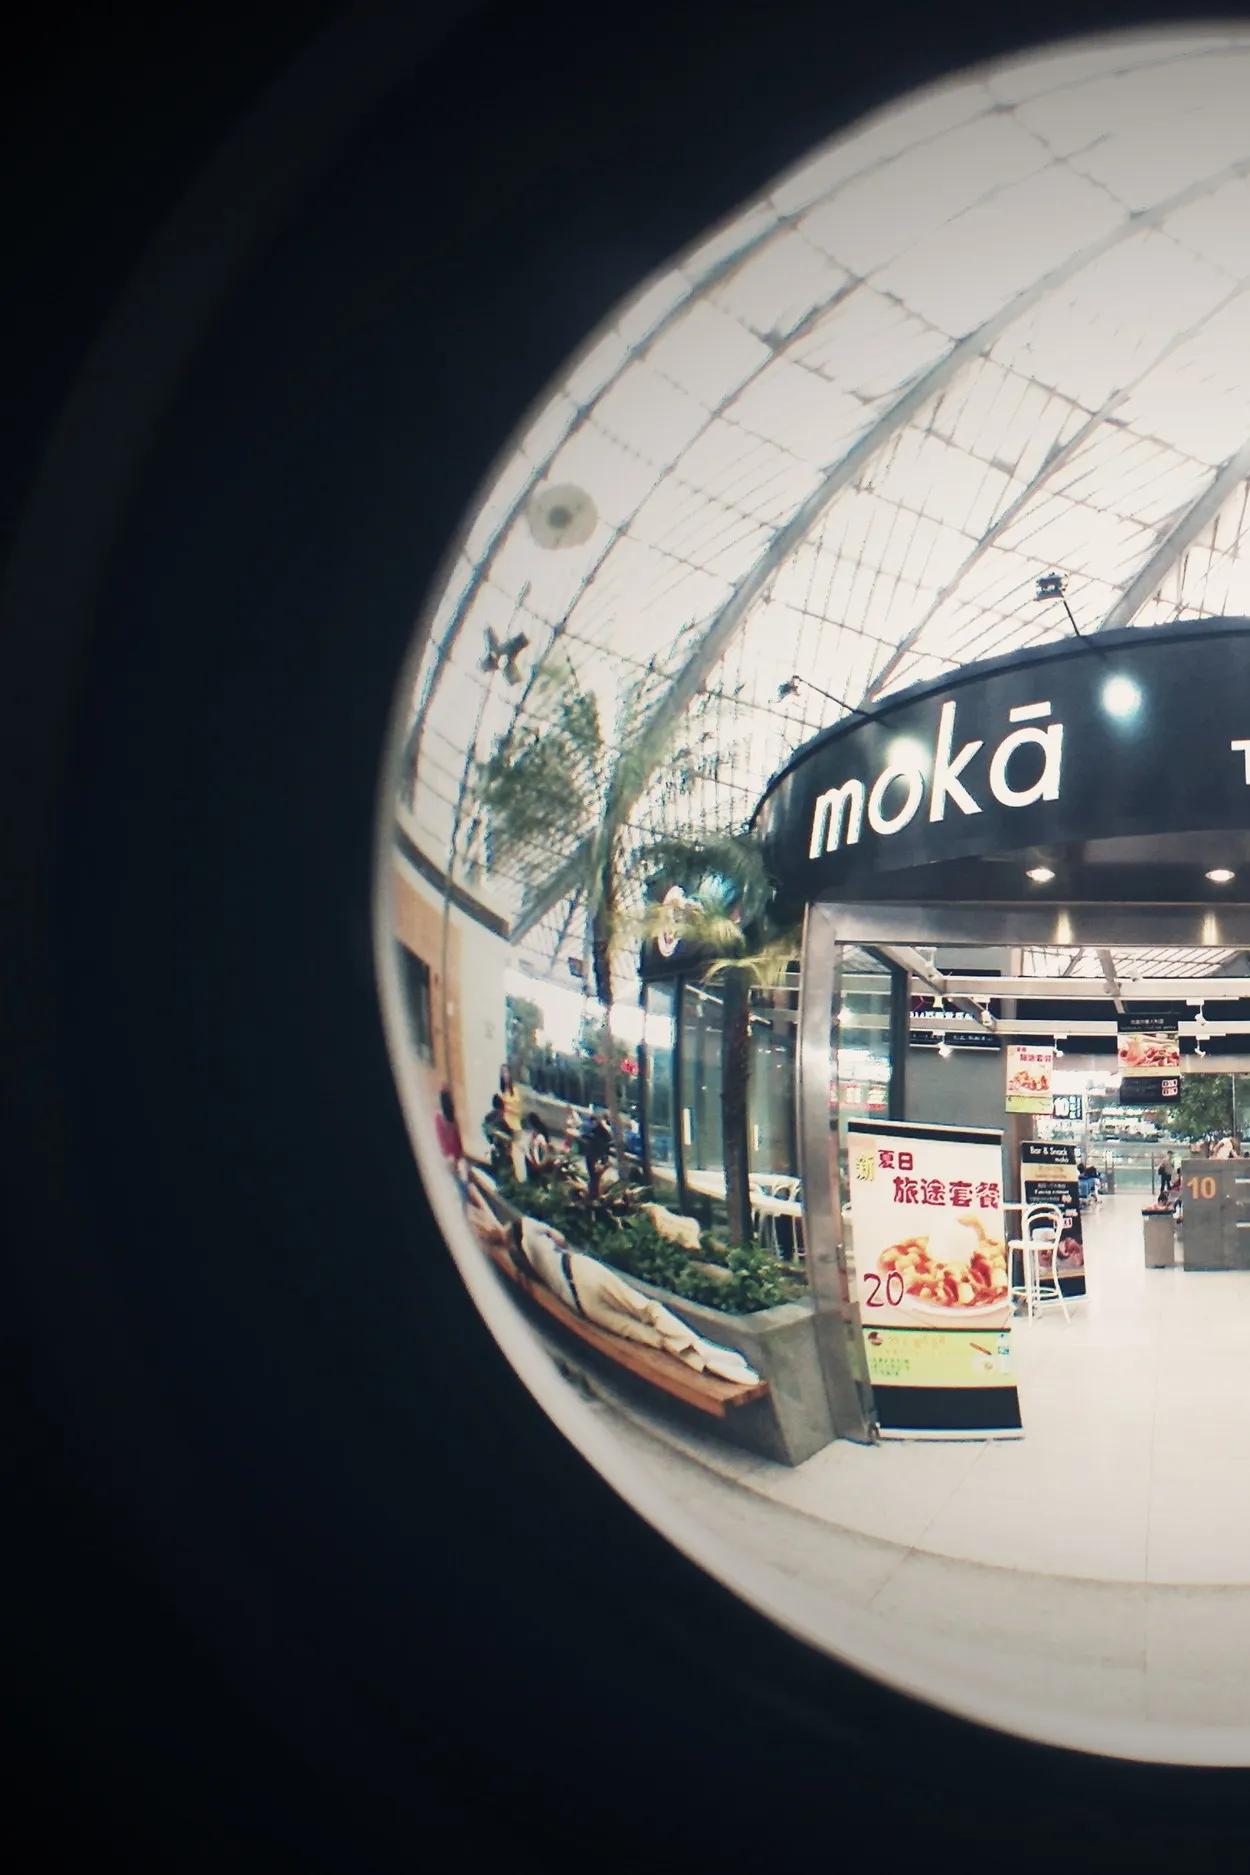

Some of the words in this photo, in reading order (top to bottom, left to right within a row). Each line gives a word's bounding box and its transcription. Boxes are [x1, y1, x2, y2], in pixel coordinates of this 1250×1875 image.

[808, 699, 1064, 859] mokā
[878, 1149, 913, 1171] 夏日
[893, 1176, 1000, 1209] 旅途套餐
[1187, 1176, 1216, 1199] 10
[863, 1271, 904, 1307] 20
